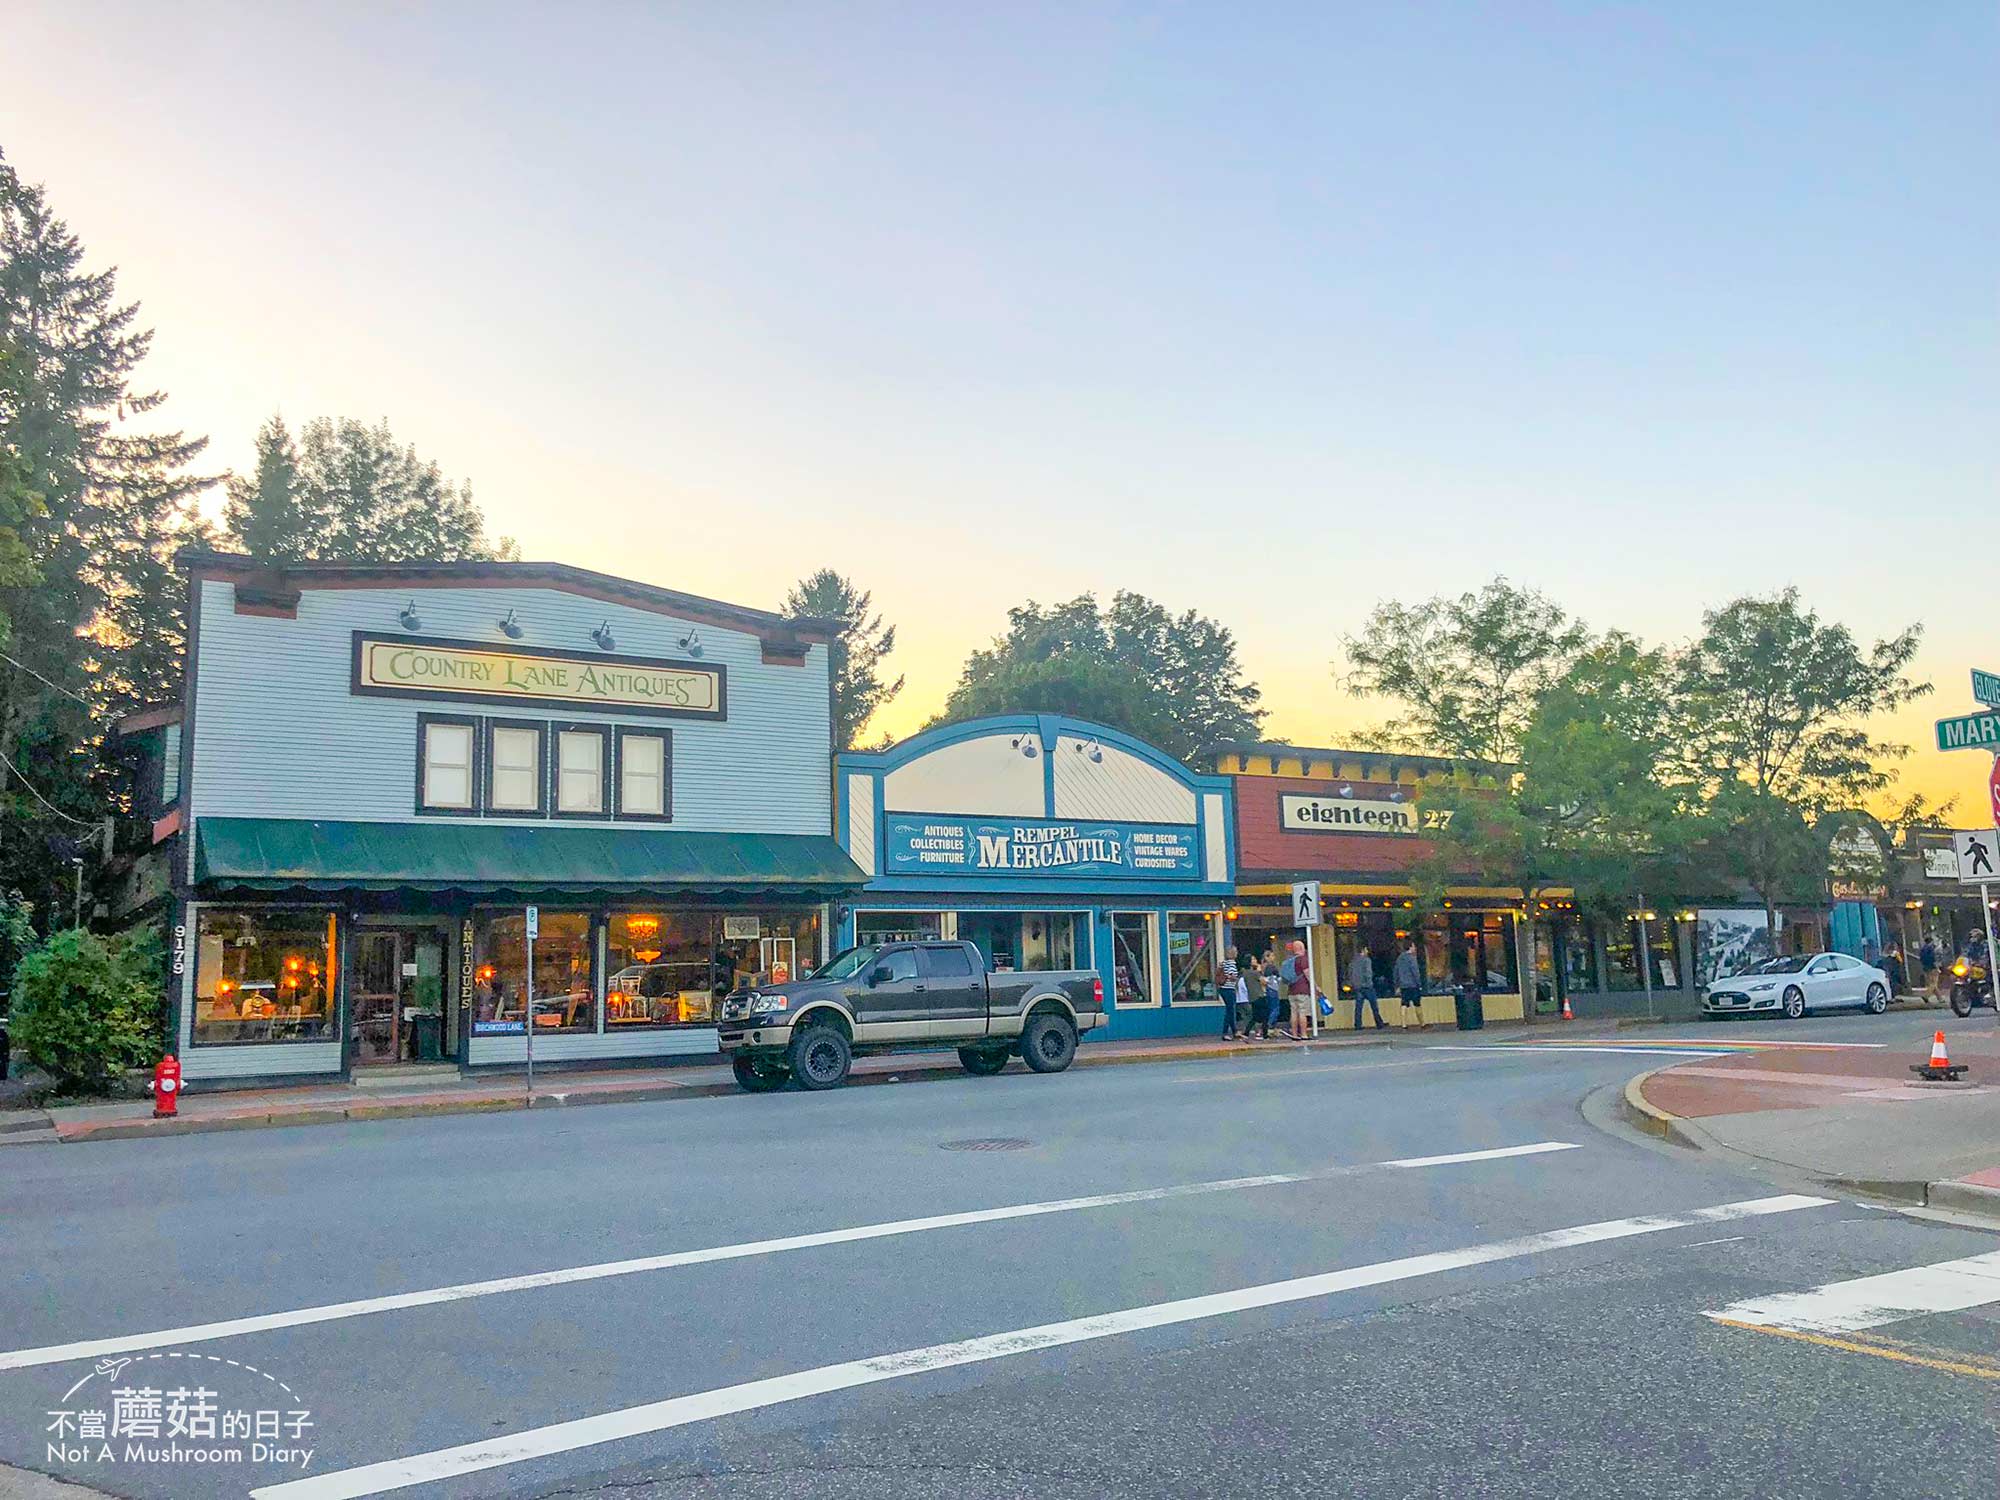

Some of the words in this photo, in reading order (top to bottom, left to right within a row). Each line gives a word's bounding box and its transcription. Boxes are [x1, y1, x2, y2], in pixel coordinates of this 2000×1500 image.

[389, 650, 495, 682] COUNTRY
[502, 660, 569, 691] LANE
[576, 665, 697, 706] ANTIQUES
[1296, 802, 1409, 829] eighteen
[1423, 809, 1455, 830] 27
[924, 825, 964, 837] ANTIQUES
[1012, 826, 1080, 843] REMPEL
[910, 838, 964, 850] COLLECTIBLES
[1133, 833, 1154, 844] HOME
[1155, 834, 1178, 845] DECOR
[920, 851, 965, 863] FURNITURE
[976, 835, 1123, 868] MERCANTILE
[1134, 845, 1164, 856] VINTAGE
[1165, 846, 1188, 857] WARES
[1134, 858, 1176, 869] CURIOSITIES
[173, 925, 186, 975] 9179
